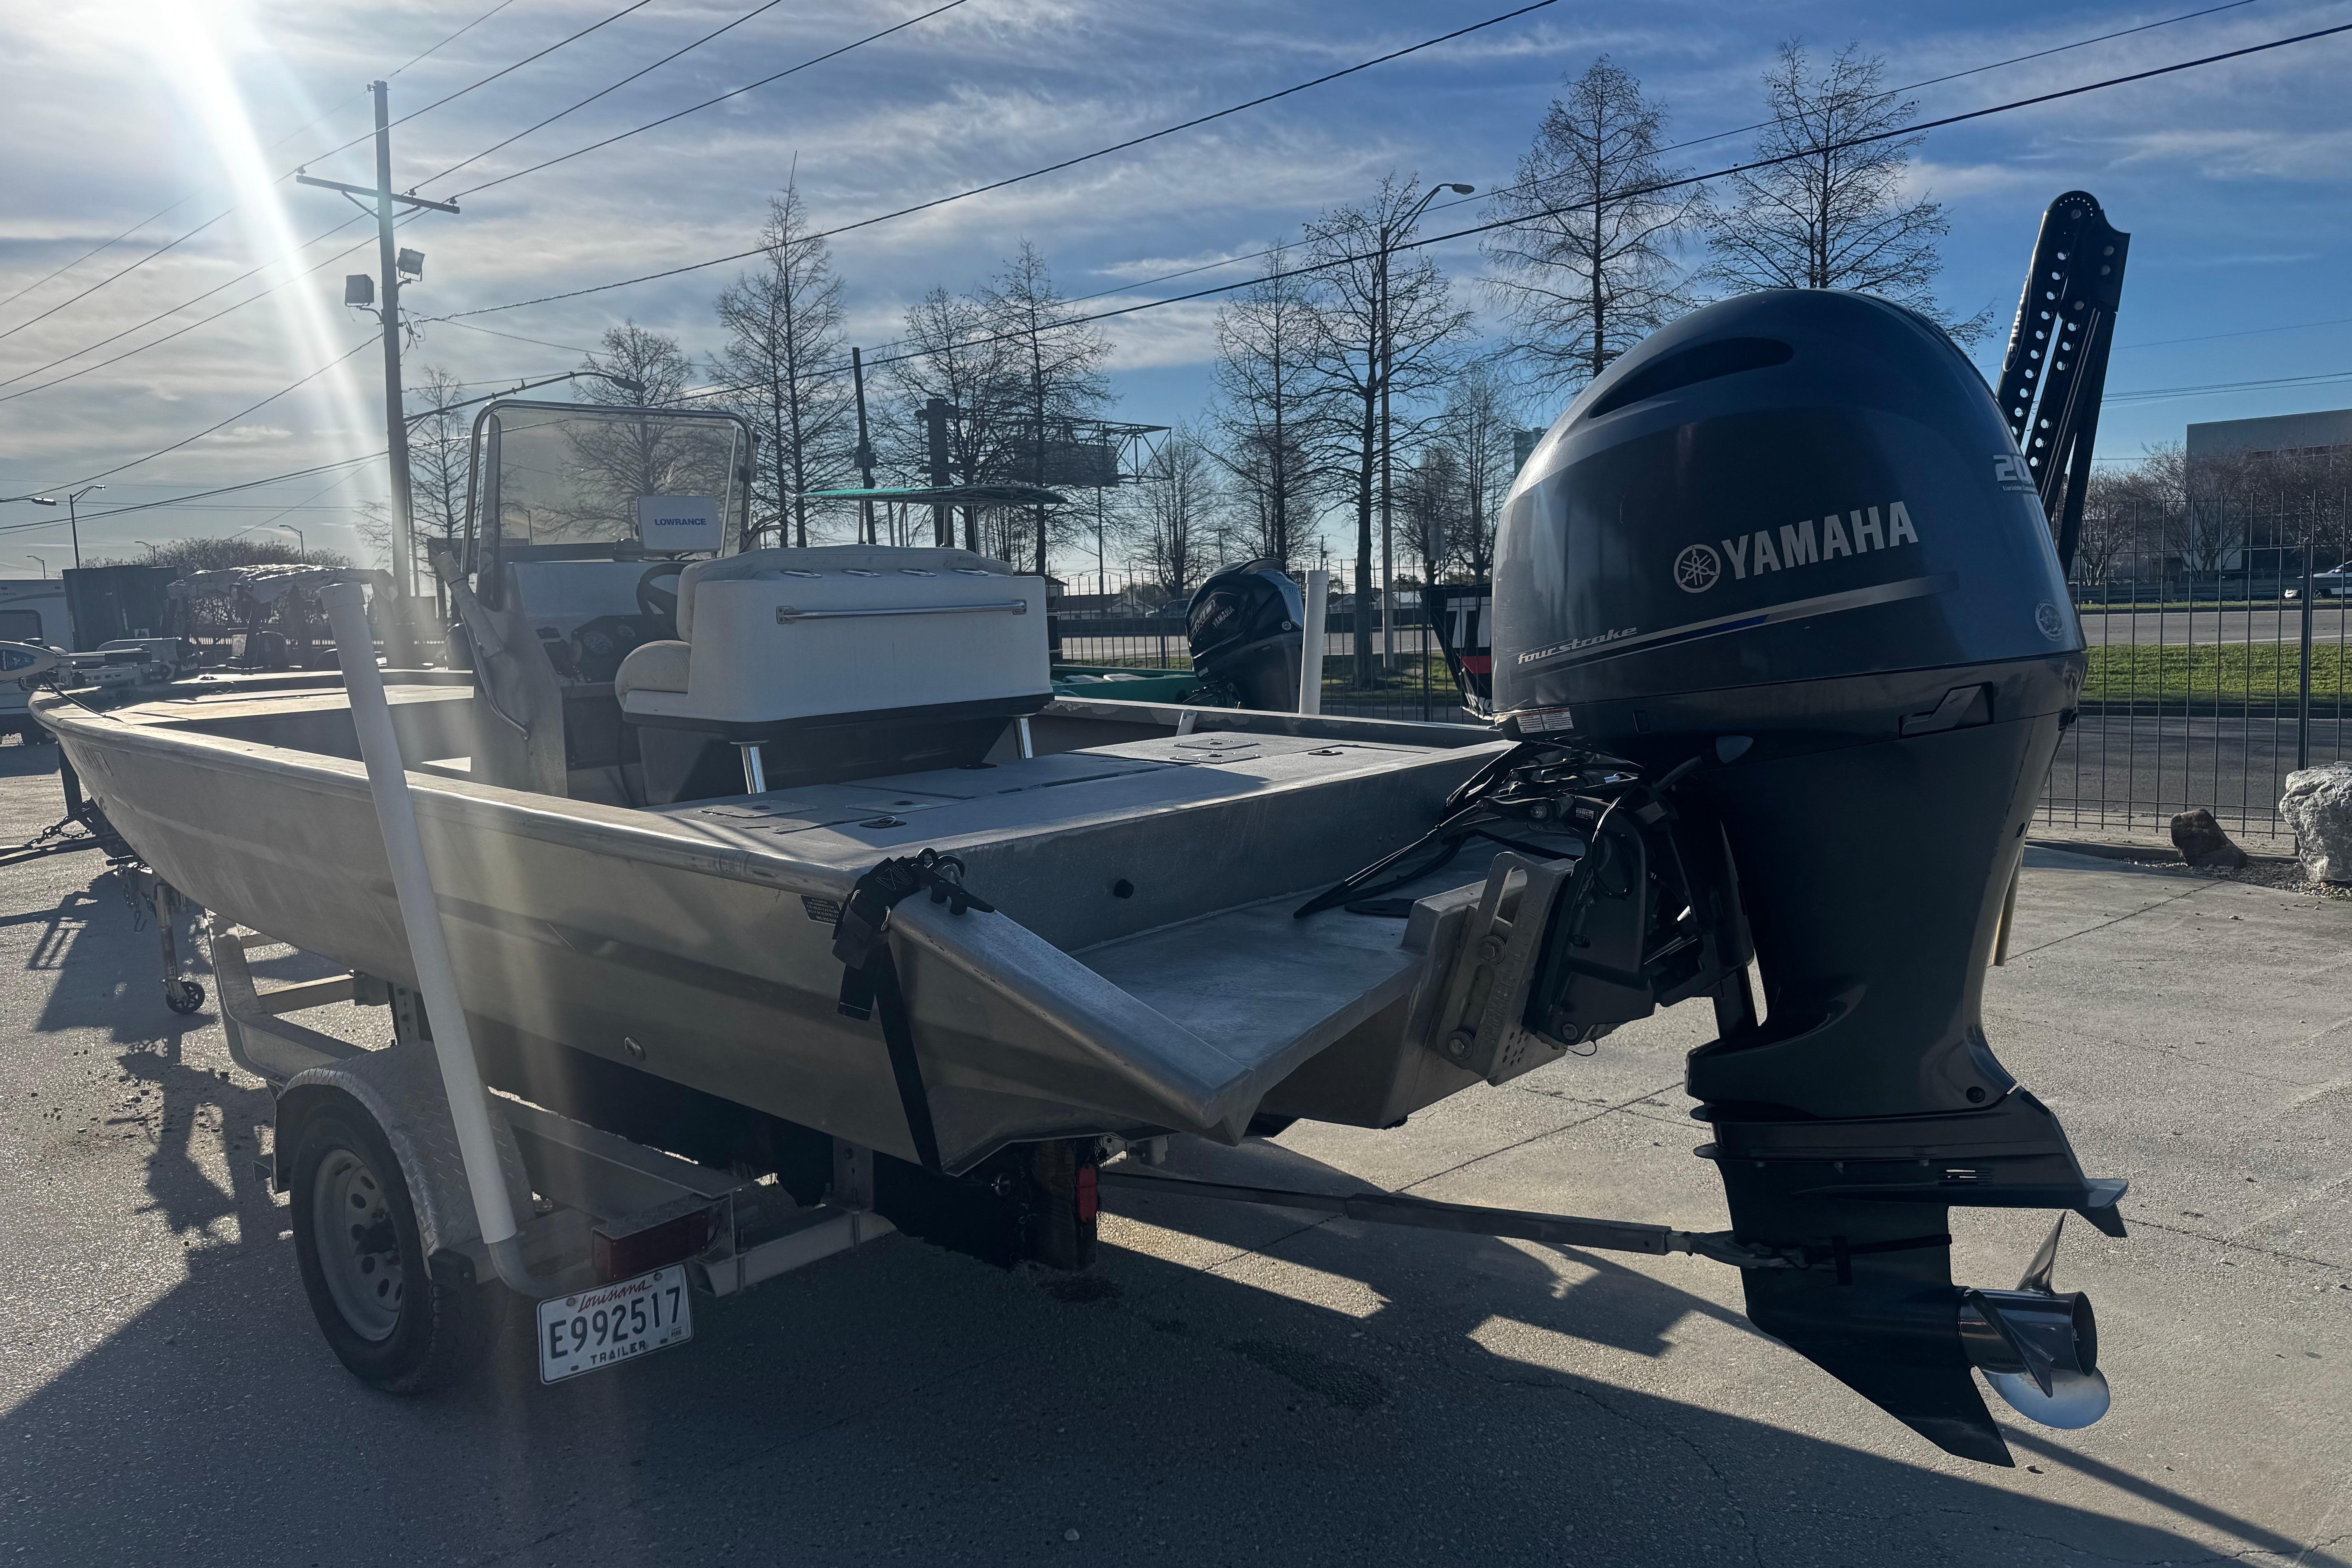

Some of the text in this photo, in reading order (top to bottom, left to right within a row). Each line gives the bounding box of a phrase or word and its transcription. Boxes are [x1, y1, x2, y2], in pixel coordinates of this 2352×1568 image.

[1722, 501, 1919, 580] YAMAHA
[1212, 605, 1235, 628] YAMAHA
[578, 1280, 653, 1313] Louisiana
[550, 1286, 680, 1359] E992517
[590, 1340, 646, 1365] TRAILER
